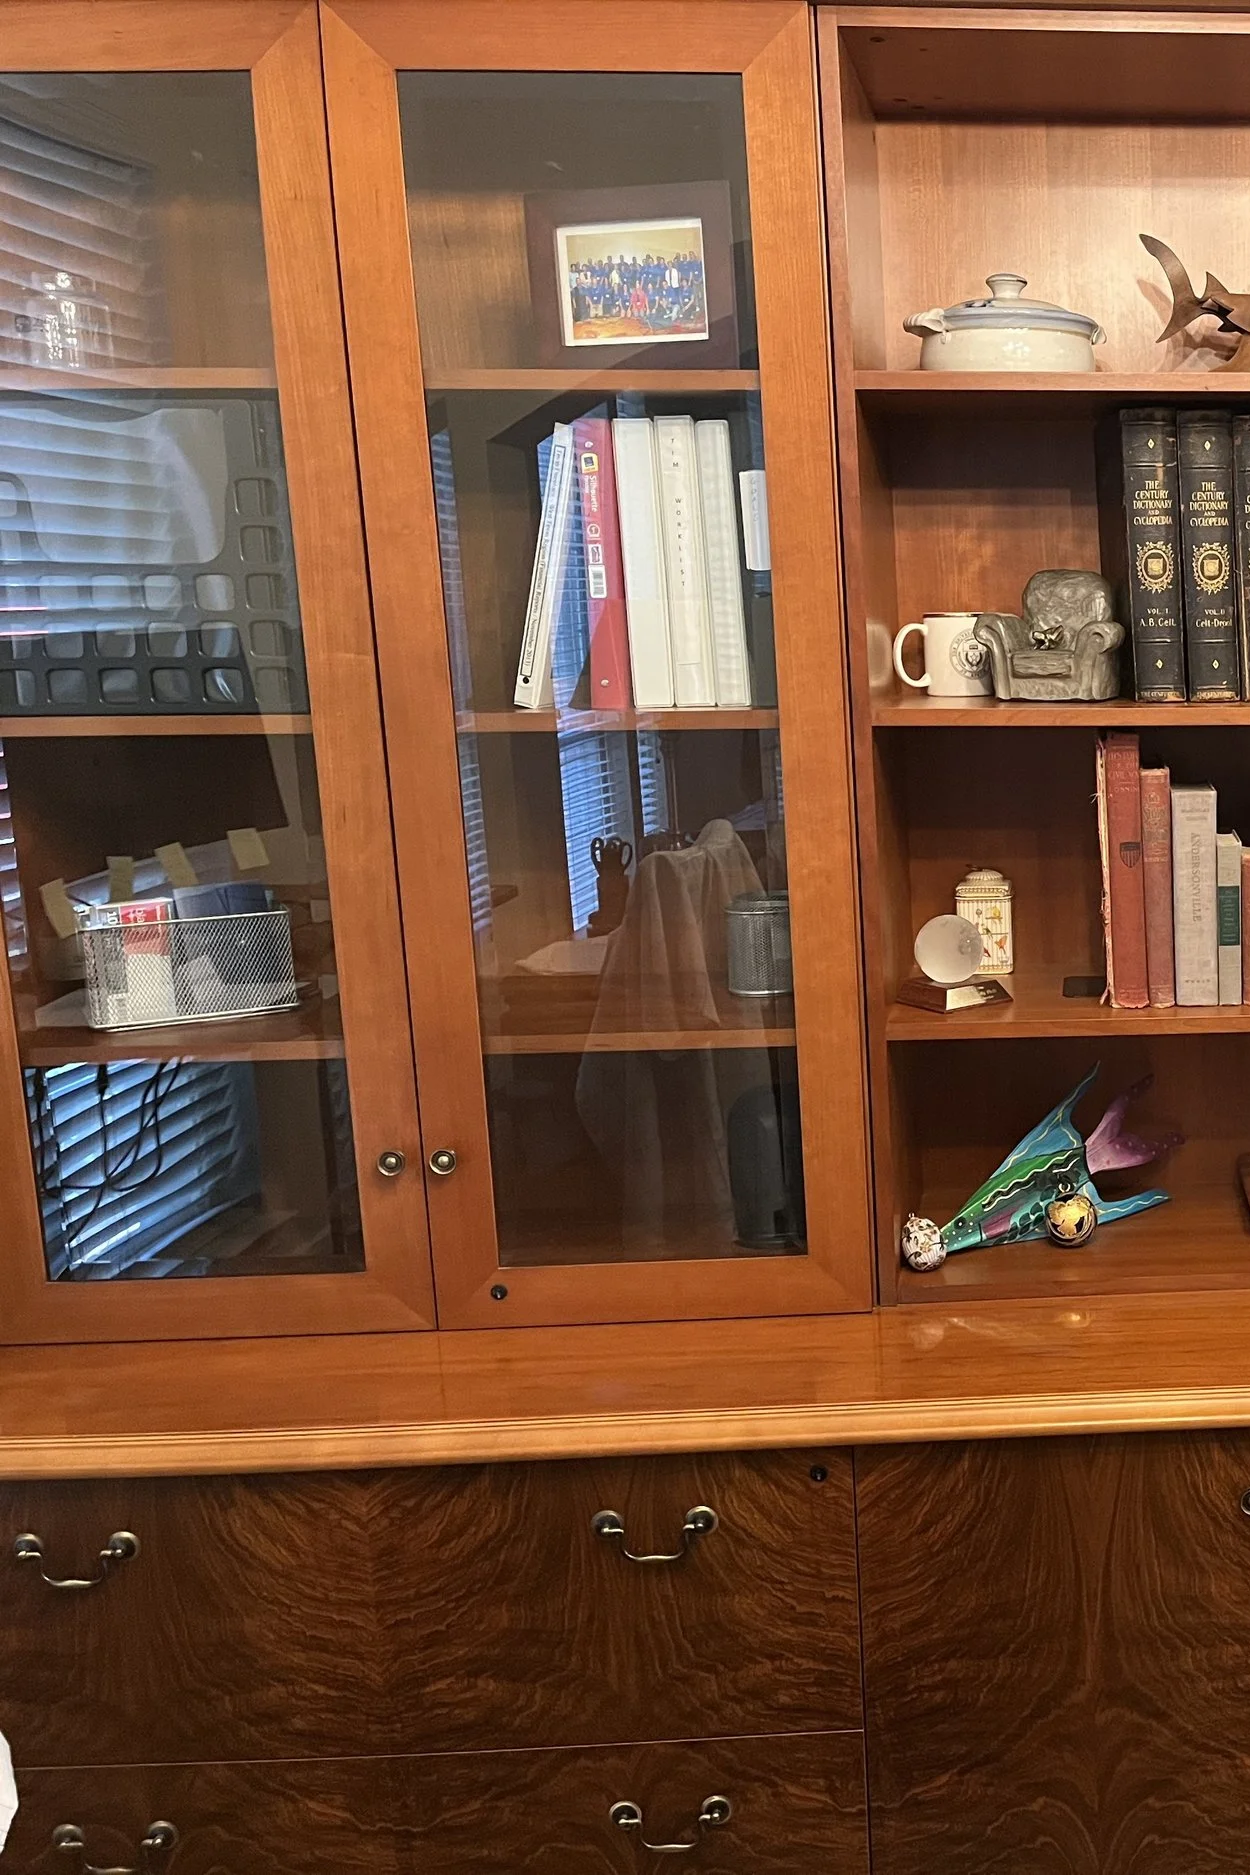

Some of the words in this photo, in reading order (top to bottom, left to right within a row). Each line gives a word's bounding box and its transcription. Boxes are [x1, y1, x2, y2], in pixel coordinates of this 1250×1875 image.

[1145, 480, 1160, 490] THE
[1201, 482, 1216, 491] THE
[589, 474, 598, 512] Silhouette
[1135, 490, 1168, 499] CENTURY
[1192, 492, 1225, 500] CENTURY
[1133, 500, 1172, 510] DICTIONARY
[1190, 501, 1228, 511] DICTIONARY
[1134, 516, 1172, 526] CYCLOPEDIA
[1190, 518, 1229, 527] CYCLOPEDIA
[1191, 832, 1202, 922] ANDERSONVILLE
[107, 911, 118, 924] 10
